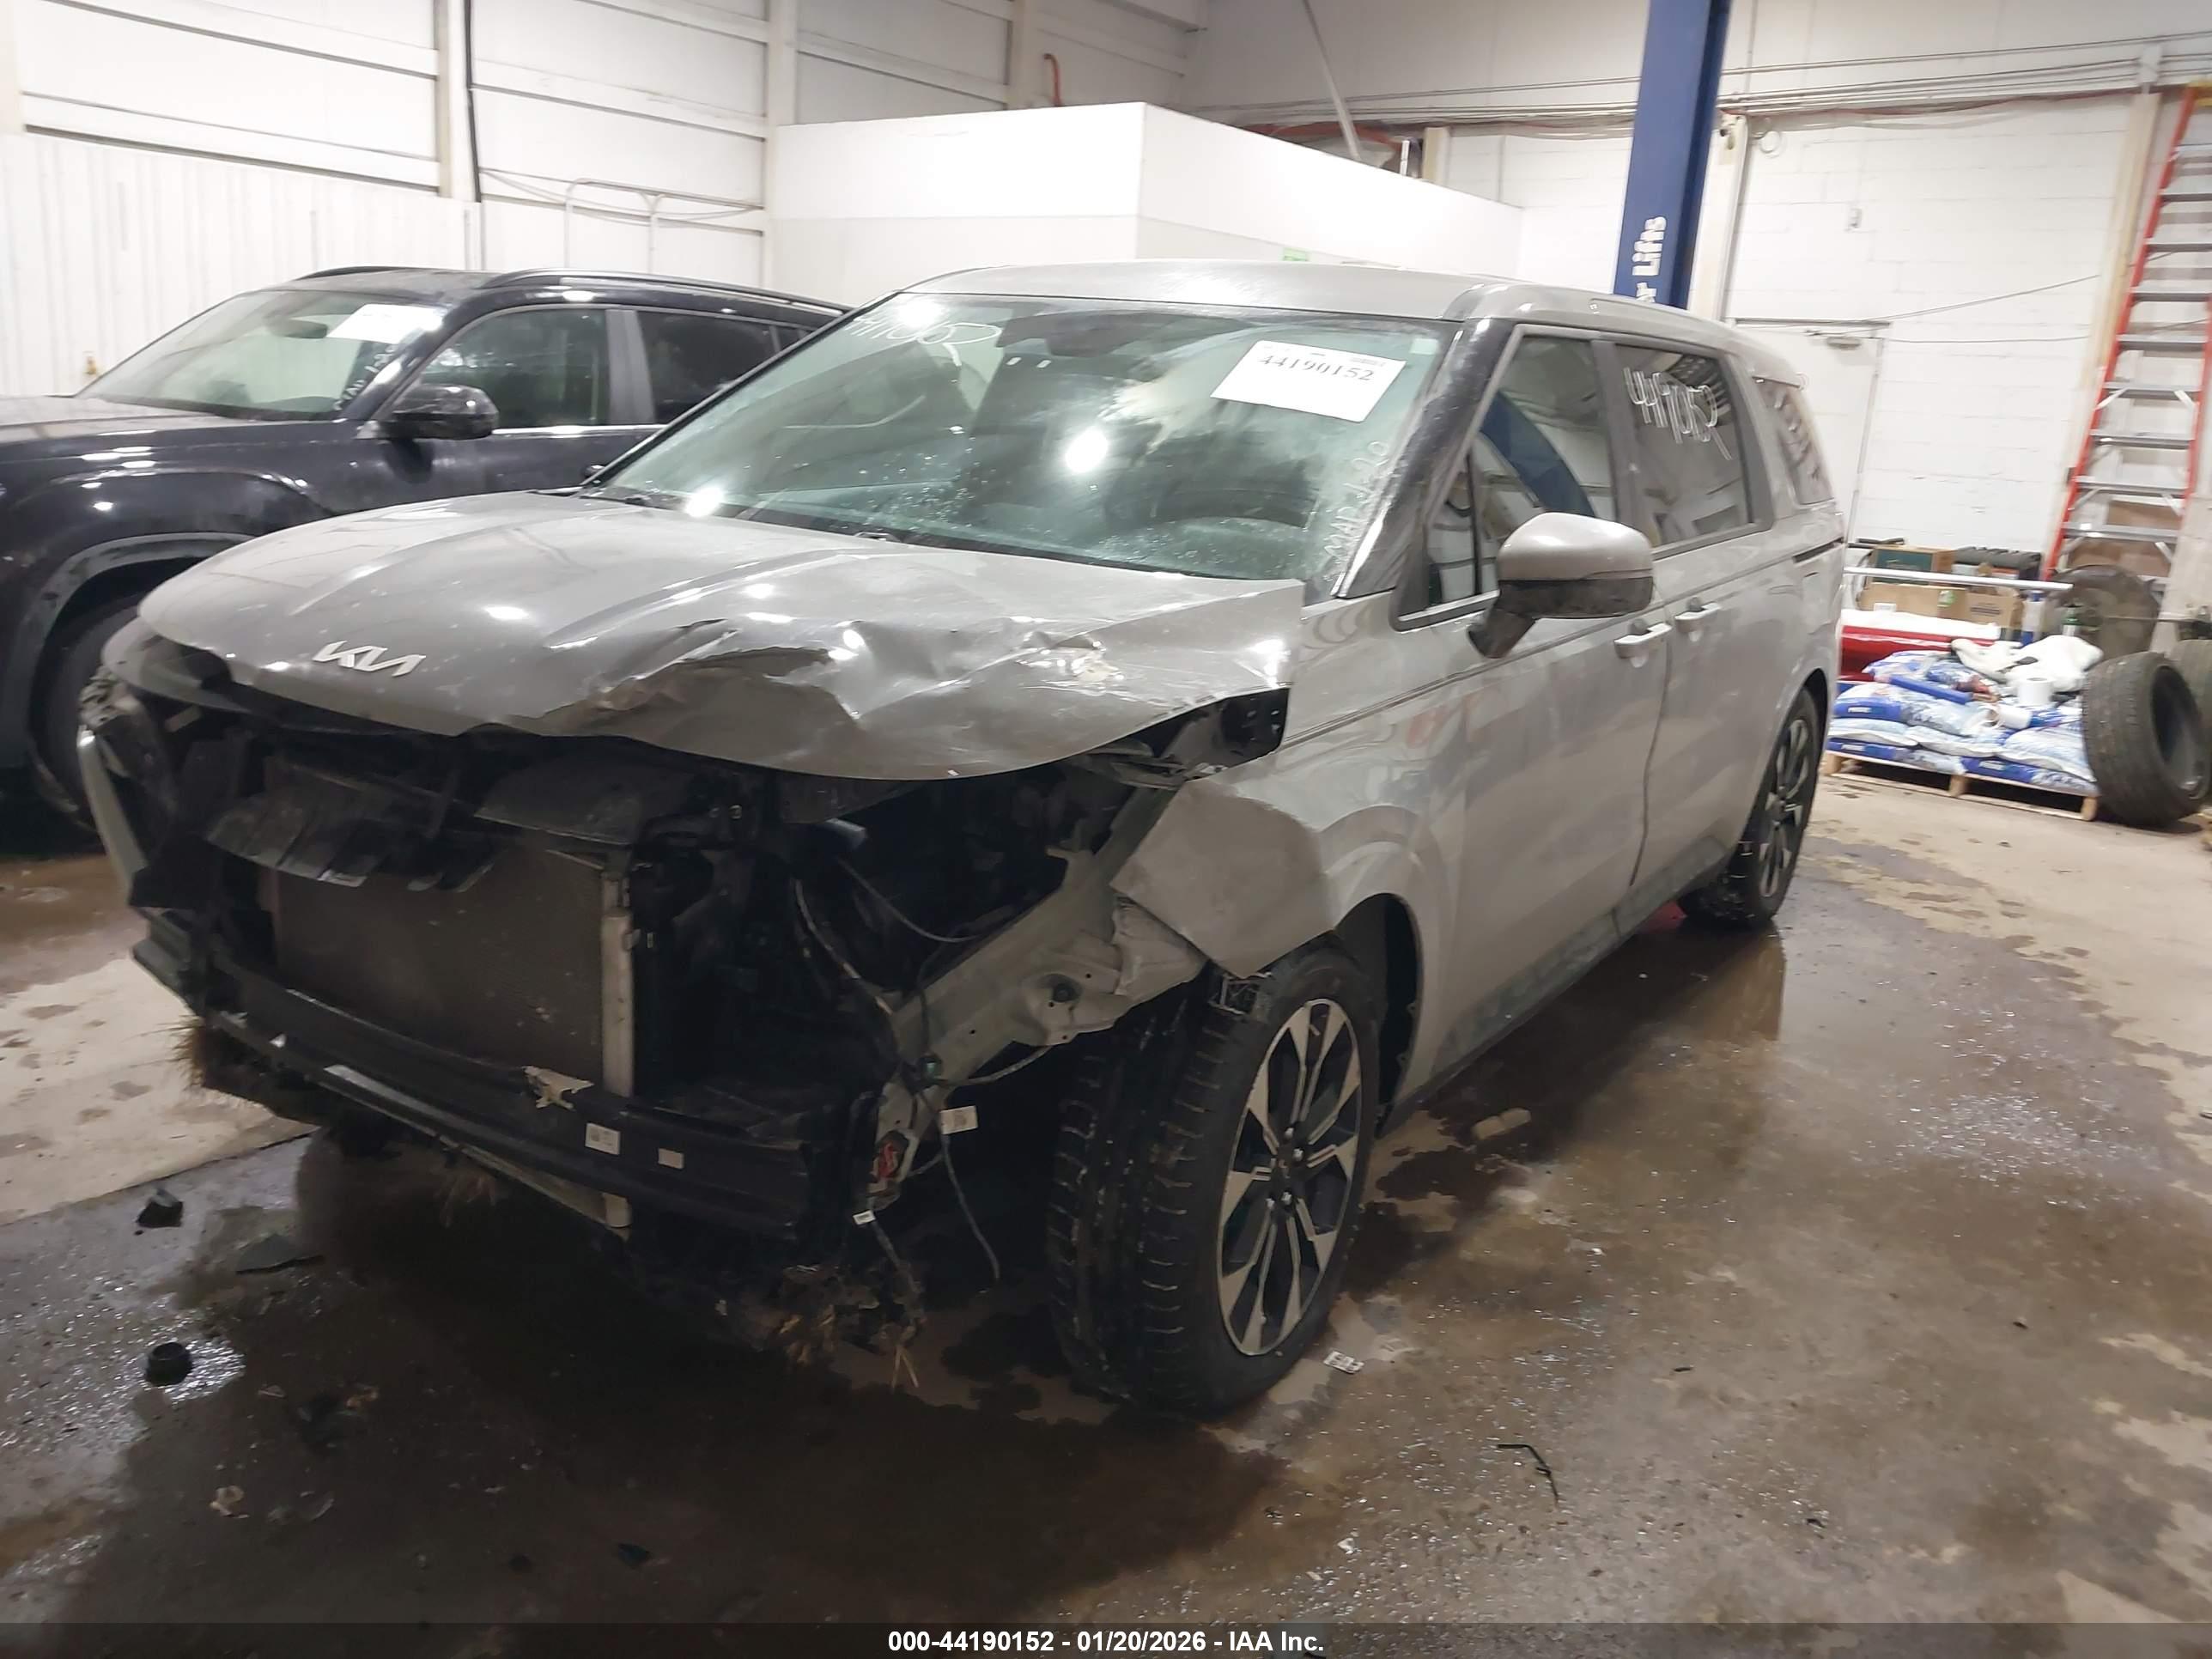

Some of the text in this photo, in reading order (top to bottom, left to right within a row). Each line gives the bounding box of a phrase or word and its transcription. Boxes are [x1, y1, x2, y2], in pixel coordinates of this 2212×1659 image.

[1632, 216, 1667, 276] Lifts
[1256, 355, 1376, 381] 44190152
[312, 640, 427, 678] KIA
